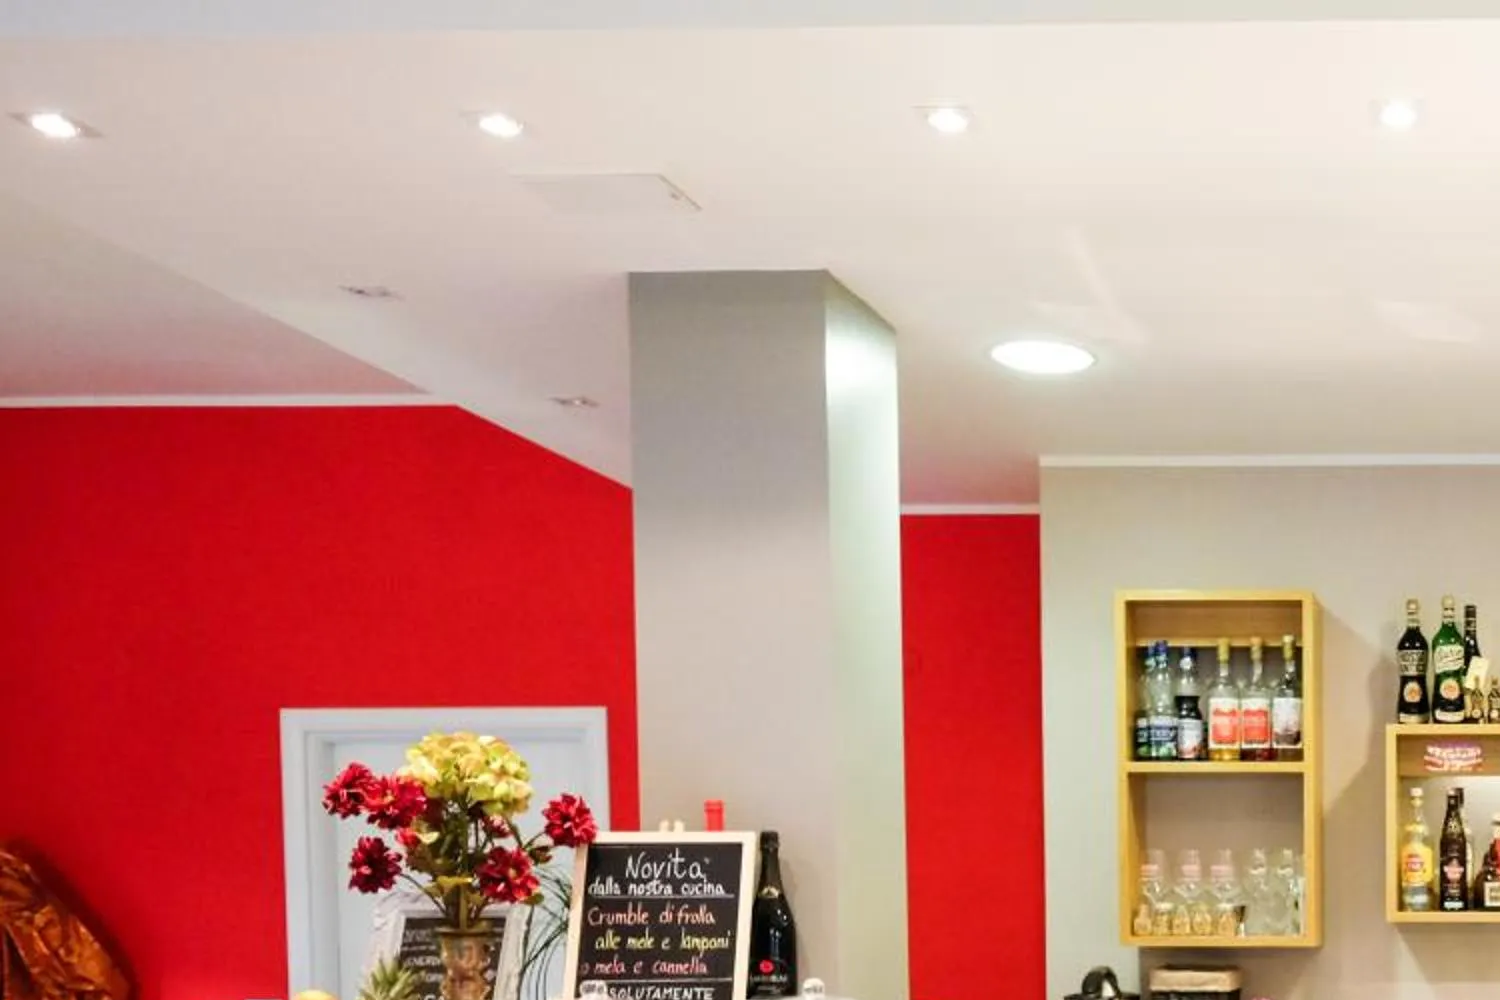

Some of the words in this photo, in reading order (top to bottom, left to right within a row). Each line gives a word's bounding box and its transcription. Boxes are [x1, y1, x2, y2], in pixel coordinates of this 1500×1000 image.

[588, 876, 621, 896] dalla
[627, 879, 673, 897] nostra
[681, 879, 726, 896] cucina
[587, 901, 649, 926] Crumble
[659, 903, 676, 924] di
[595, 928, 621, 950] alle
[626, 927, 655, 950] mele
[661, 937, 672, 950] e
[594, 954, 627, 975] mela
[633, 960, 643, 974] e
[652, 955, 708, 975] cannella
[609, 986, 715, 1000] SOLUTAMENTE
